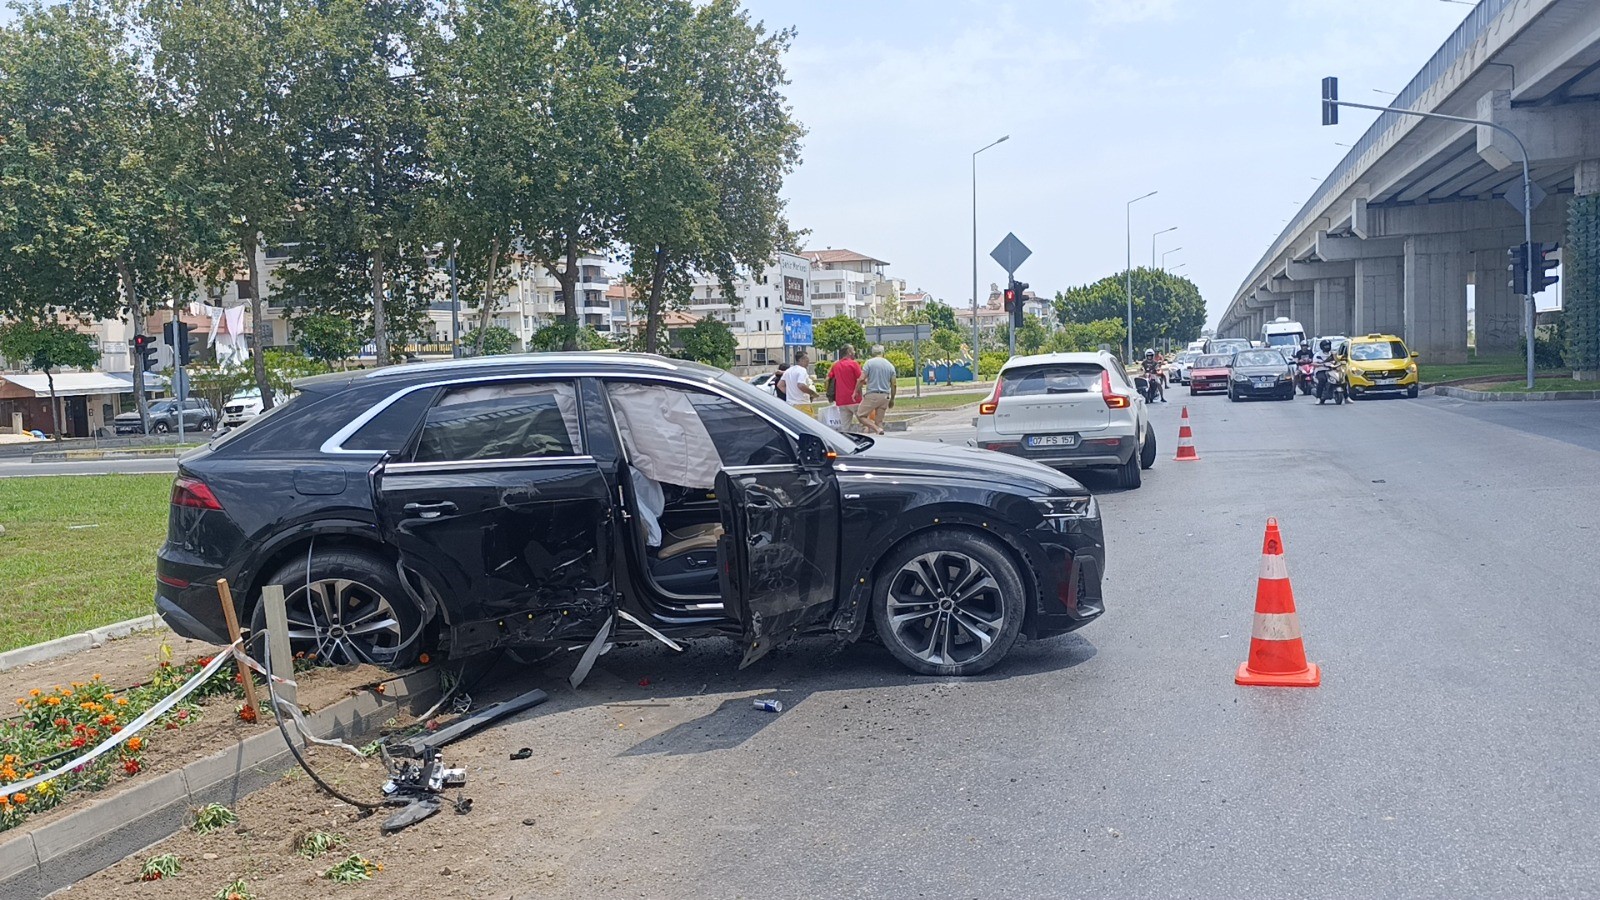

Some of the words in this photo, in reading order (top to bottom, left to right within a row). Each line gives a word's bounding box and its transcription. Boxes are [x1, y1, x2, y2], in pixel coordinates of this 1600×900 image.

[1033, 437, 1043, 445] 07
[1046, 436, 1058, 444] FS
[1061, 436, 1074, 444] 157
